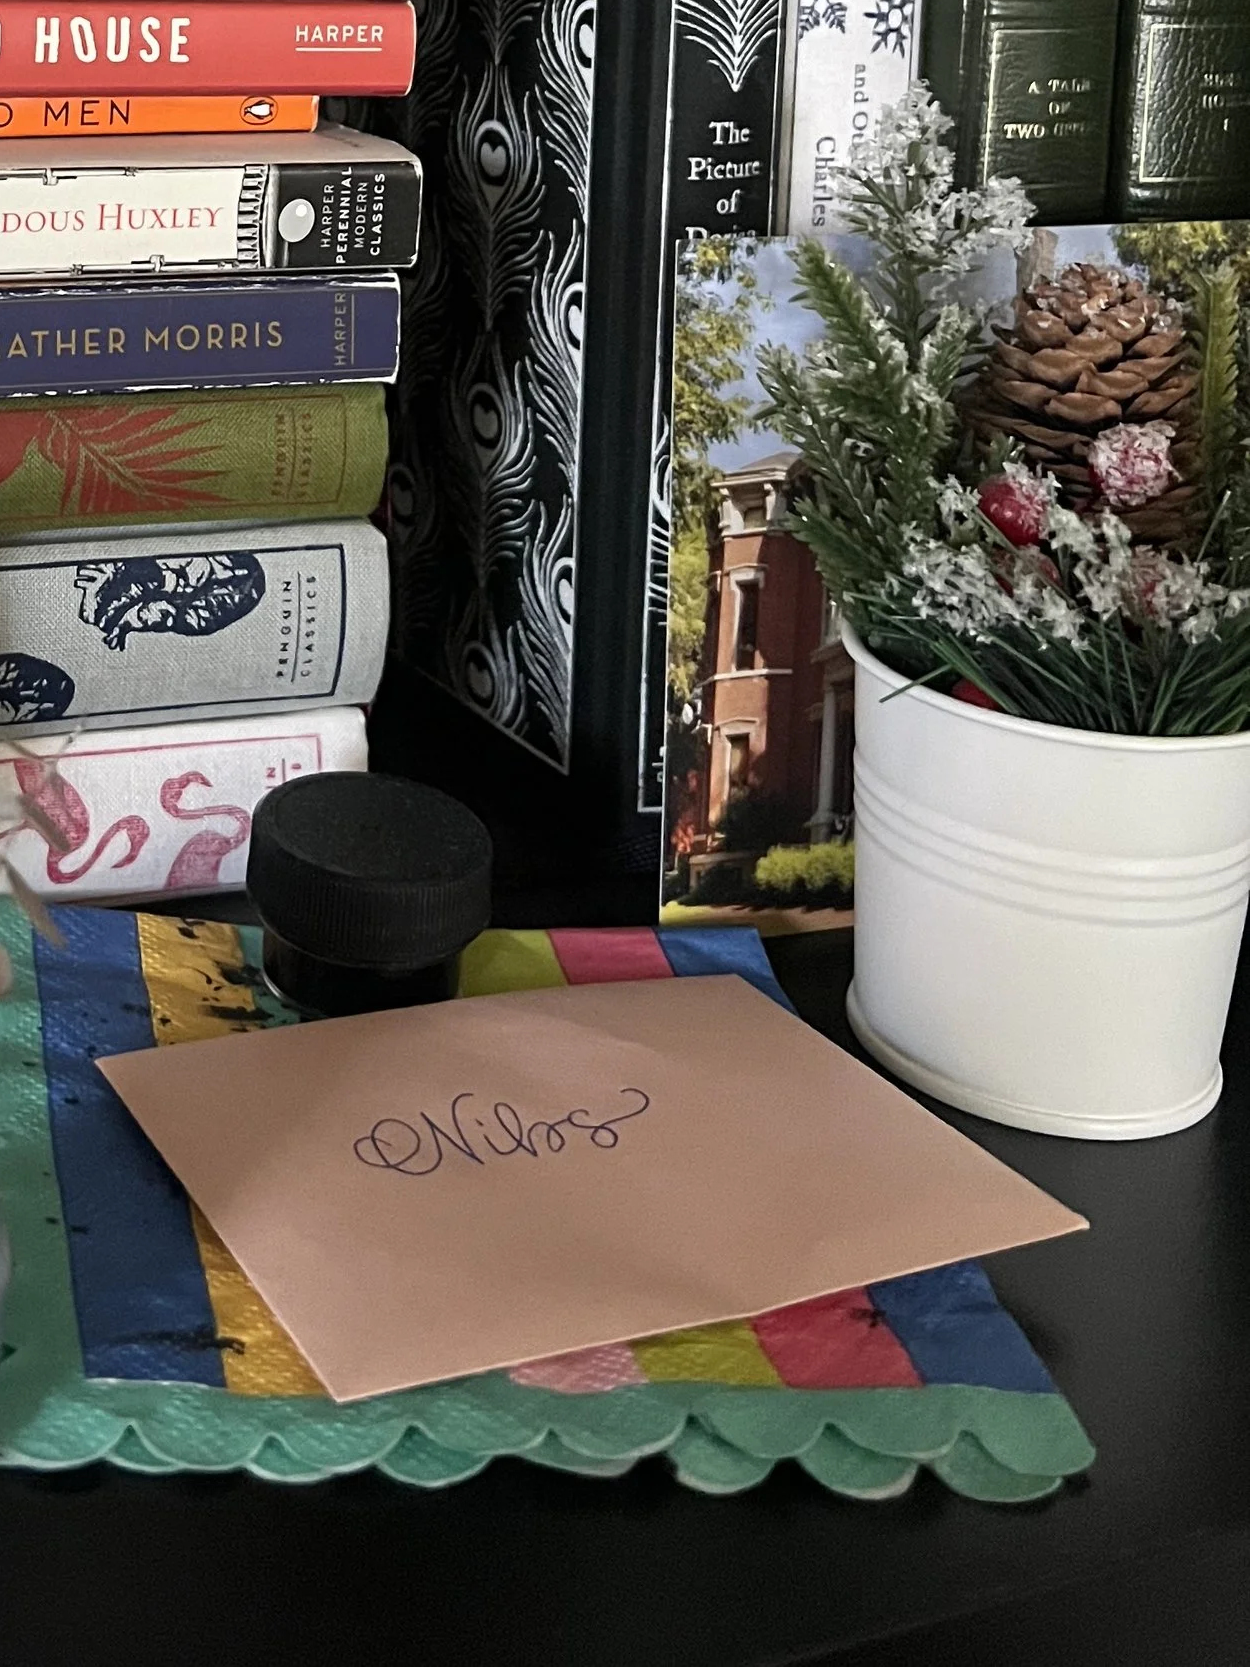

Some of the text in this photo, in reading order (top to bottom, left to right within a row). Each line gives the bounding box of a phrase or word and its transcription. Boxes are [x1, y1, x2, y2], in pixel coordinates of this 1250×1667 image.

[35, 15, 191, 64] HOUSE
[295, 25, 384, 42] HARPER
[854, 64, 869, 104] and
[43, 99, 132, 128] MEN
[708, 121, 750, 145] The
[1003, 123, 1045, 140] TWO
[687, 157, 761, 181] Picture
[812, 136, 836, 227] Charles
[320, 183, 335, 248] HARPER
[336, 166, 352, 264] PERENNIAL
[354, 181, 369, 248] MODERN
[370, 173, 386, 256] CLASSICS
[716, 190, 741, 215] of
[145, 320, 284, 353] MORRIS
[334, 292, 347, 366] HARPER
[276, 581, 292, 678] PENGUIN
[301, 576, 316, 677] CLASSICS
